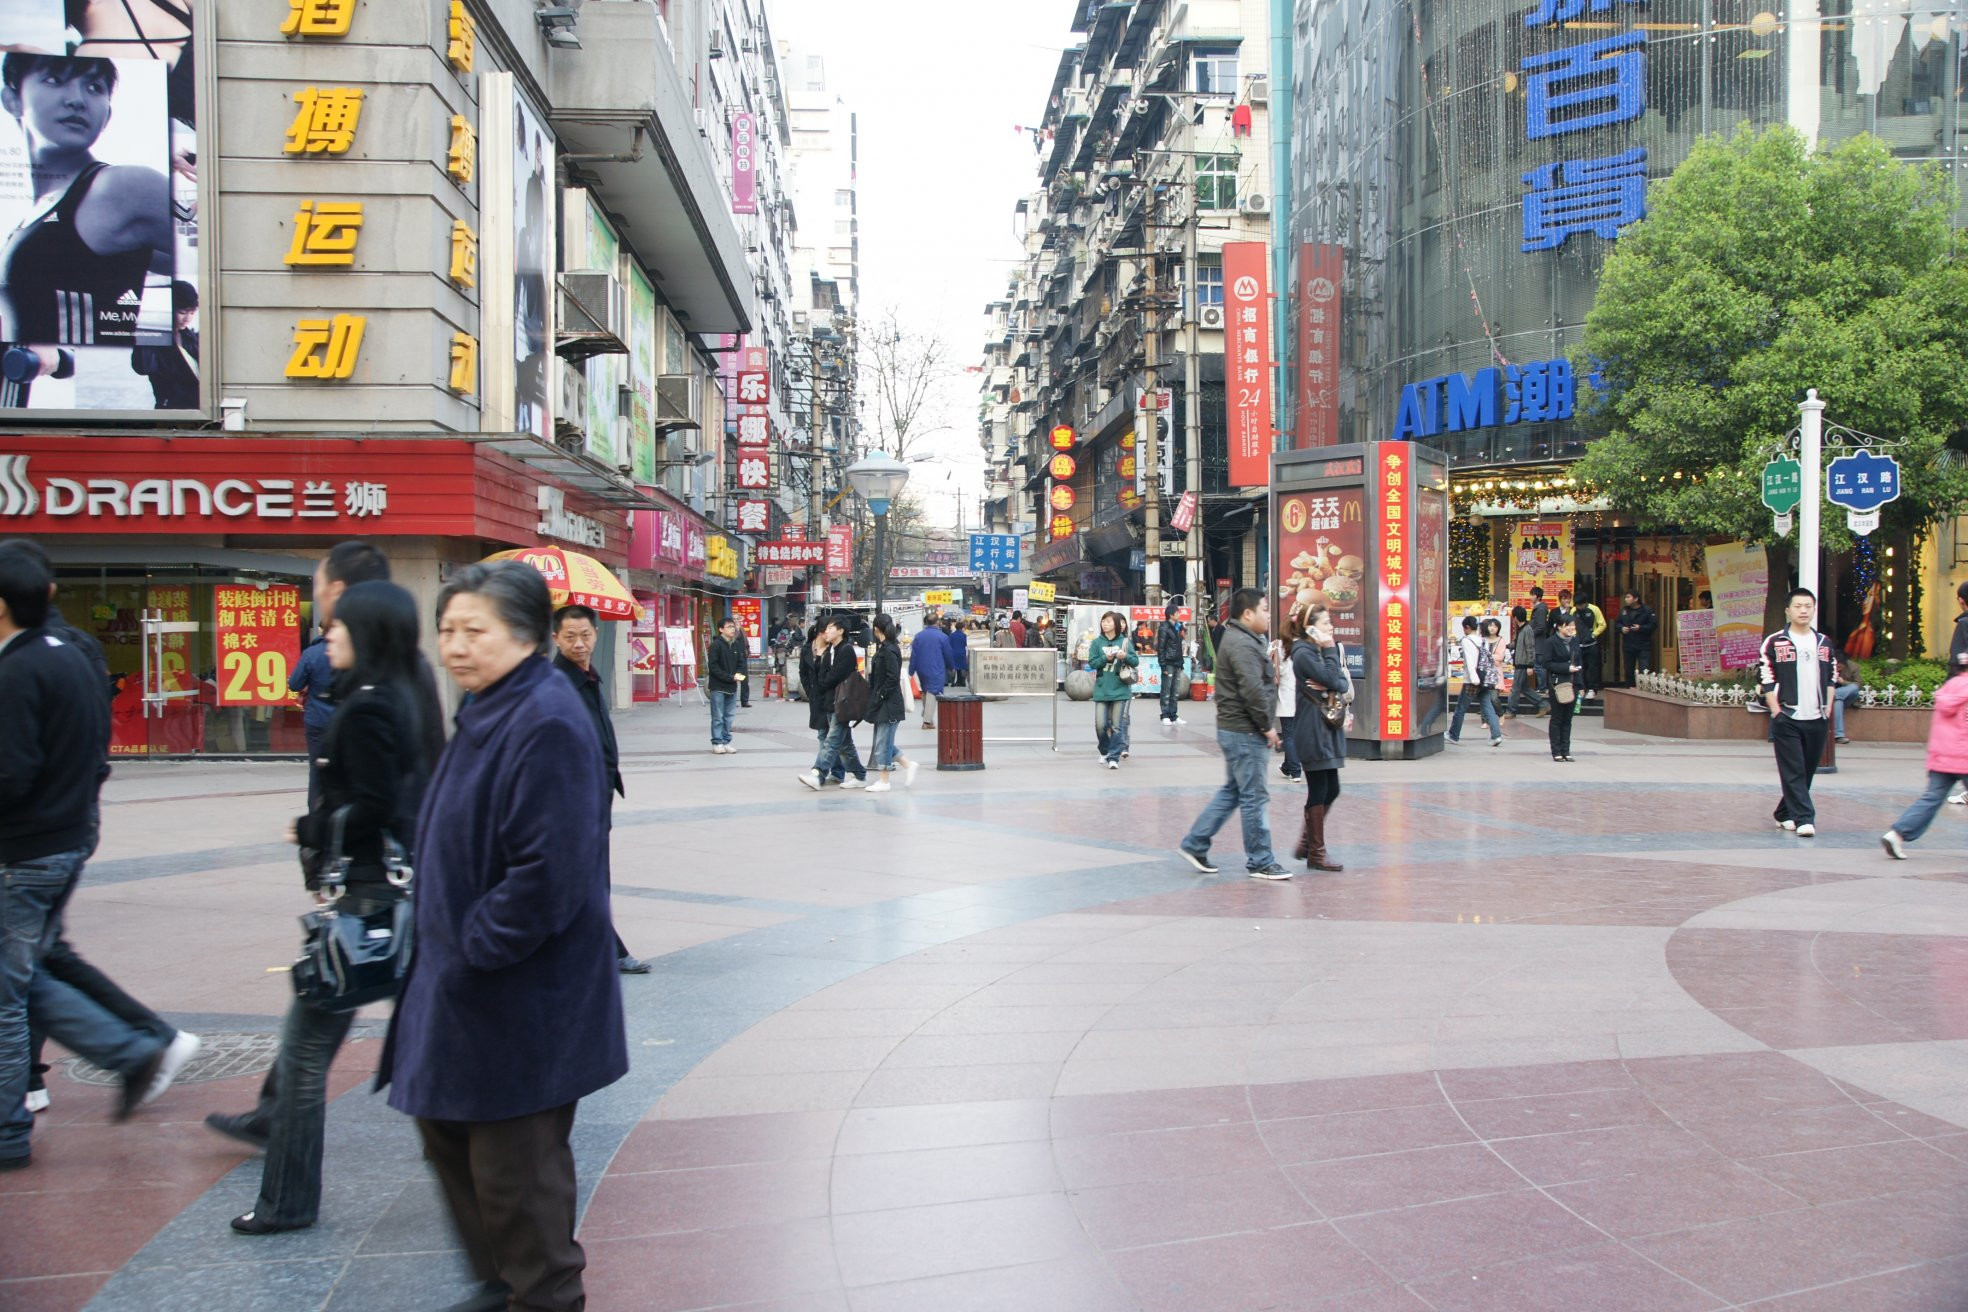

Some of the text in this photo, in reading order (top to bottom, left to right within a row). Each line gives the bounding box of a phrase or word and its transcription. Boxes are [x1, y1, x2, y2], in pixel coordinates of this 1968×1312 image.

[1520, 0, 1647, 252] 百貨
[1242, 306, 1259, 384] 招商银行
[1238, 388, 1261, 407] 24
[1391, 366, 1500, 440] ATM
[740, 373, 767, 530] 乐娜快餐
[1053, 428, 1073, 536] 宝岛牛排
[1767, 472, 1798, 485] 江汉一路
[1835, 471, 1892, 485] 江汉路
[46, 478, 294, 517] DRANCE
[298, 481, 388, 517] 兰狮
[1311, 497, 1340, 517] 天天
[1311, 516, 1340, 530] 超值选
[1386, 454, 1403, 587] 争创全国文明城市
[975, 536, 1015, 546] 江汉路
[757, 545, 824, 560] 特色烧烤小吃
[975, 548, 1015, 558] 步行街
[218, 590, 298, 608] 装修倒计时
[218, 609, 298, 627] 彻底清仓
[223, 633, 258, 649] 棉衣
[223, 651, 287, 701] 29
[1386, 603, 1403, 735] 建设美好幸福家园
